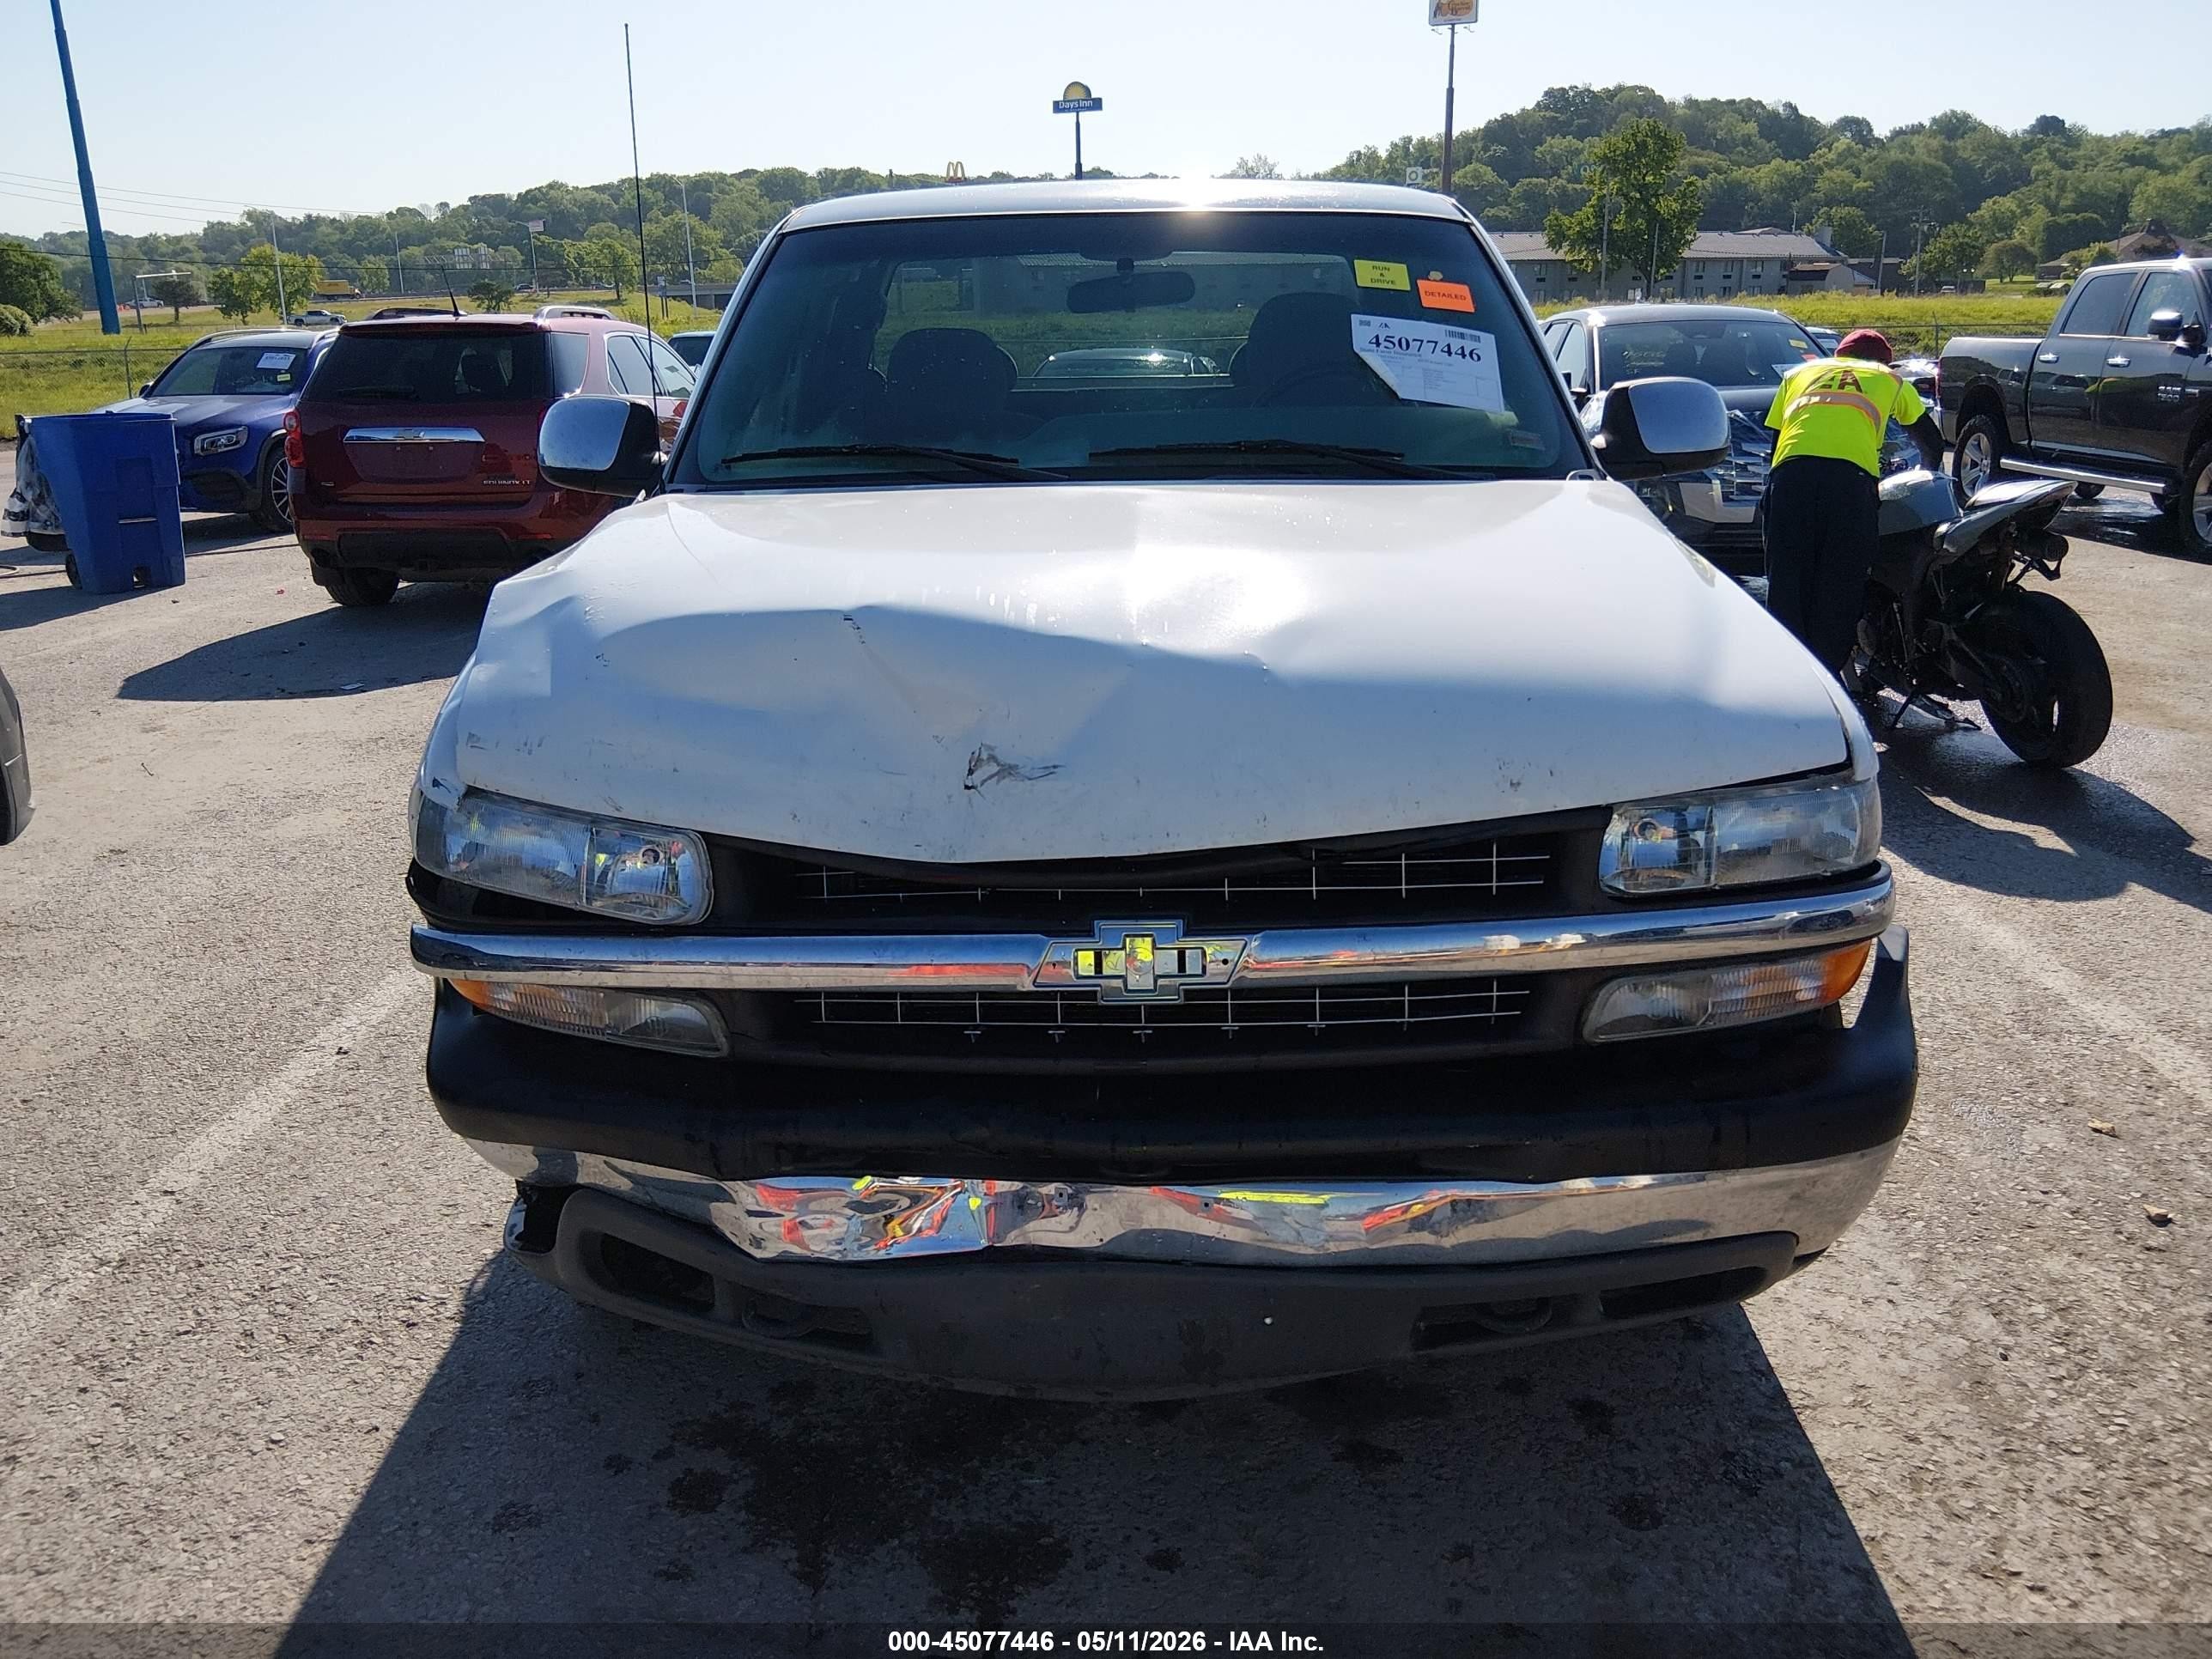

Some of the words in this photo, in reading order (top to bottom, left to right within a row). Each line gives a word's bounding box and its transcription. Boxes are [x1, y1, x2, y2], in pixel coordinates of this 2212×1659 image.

[1059, 100, 1079, 109] Days
[1079, 99, 1093, 107] Inn
[1425, 290, 1467, 301] DETAILED
[1368, 333, 1481, 362] 45077446
